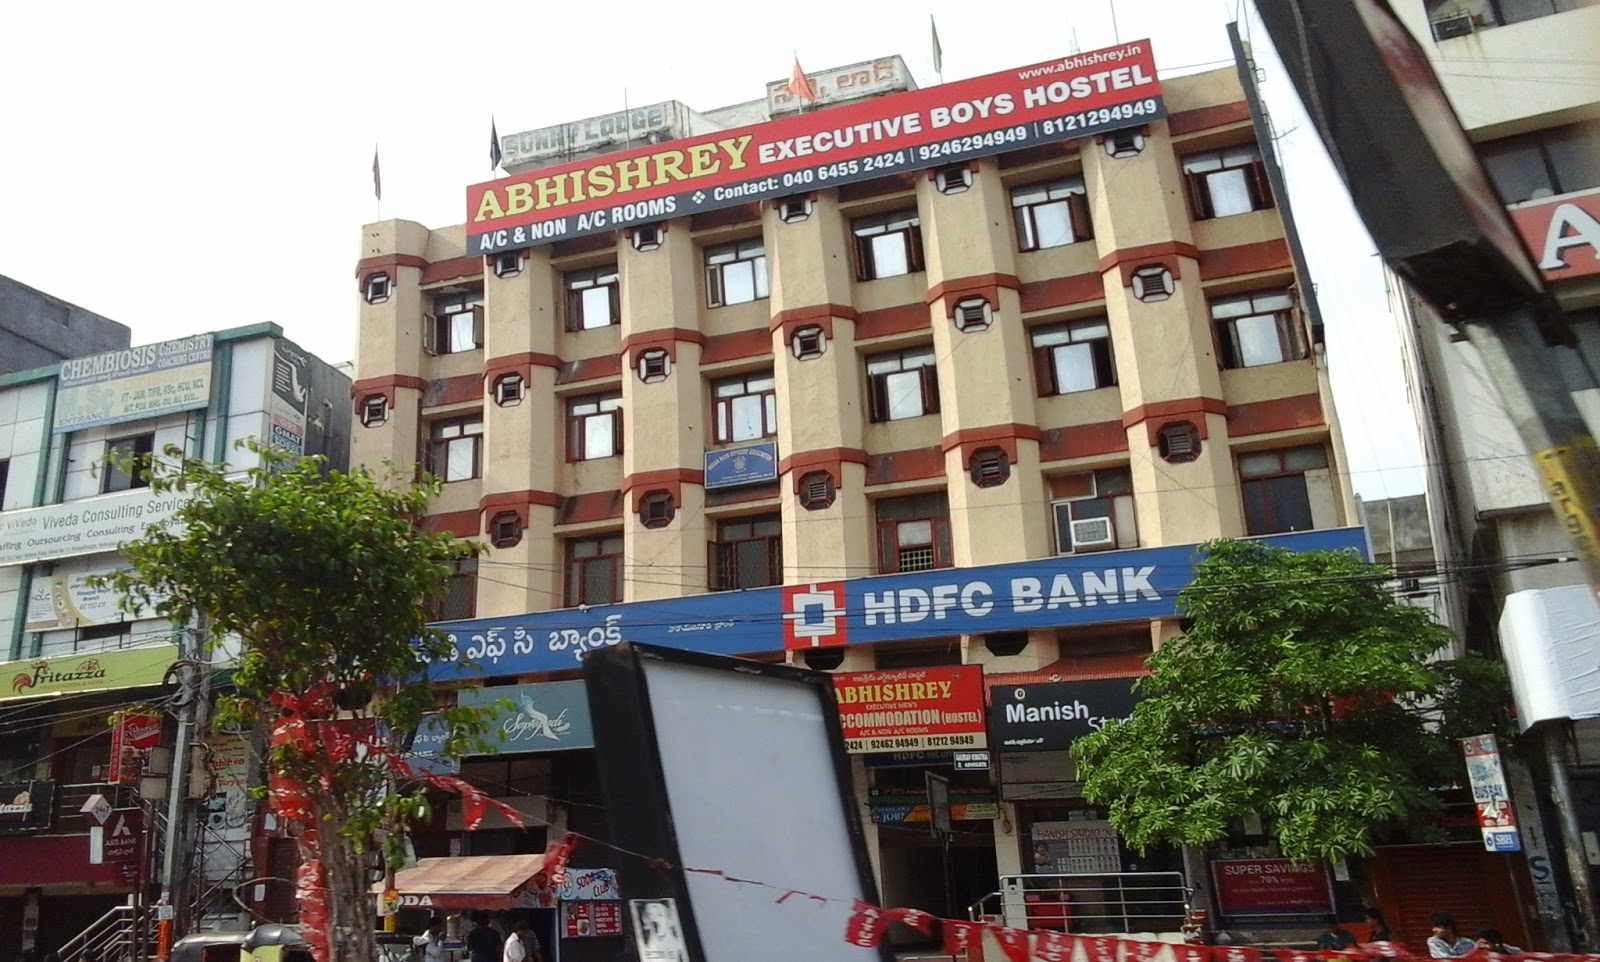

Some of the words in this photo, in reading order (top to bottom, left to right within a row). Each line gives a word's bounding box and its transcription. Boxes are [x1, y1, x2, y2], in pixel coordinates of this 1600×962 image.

[1018, 45, 1141, 80] www.abhishrey.in
[584, 108, 662, 141] LODGE
[473, 134, 753, 223] ABHISHREY
[758, 111, 923, 164] EXECUTIVE
[929, 92, 1016, 129] BOYS
[1023, 64, 1153, 109] HOSTEL
[480, 230, 507, 250] A/C
[513, 226, 526, 243] &
[531, 217, 567, 239] NON
[577, 209, 606, 231] A/C
[611, 196, 677, 224] ROOMS
[713, 177, 779, 201] Contact:
[783, 169, 813, 187] 040
[817, 160, 859, 181] 6455
[863, 151, 905, 172] 2424
[919, 125, 1028, 160] 9246294949
[1043, 99, 1157, 135] 8121294949
[60, 345, 157, 382] CHEMBIOSIS
[159, 334, 212, 356] CHEMISTRY
[275, 426, 301, 444] GMAT
[43, 513, 78, 529] Viveda
[82, 503, 143, 524] Consulting
[146, 497, 196, 514] Service
[27, 532, 81, 547] Outsourcing
[86, 524, 135, 538] Consulting
[864, 581, 994, 626] HDFC
[1011, 564, 1163, 614] BANK
[839, 709, 940, 729] CCOMMODATION
[941, 709, 982, 725] (HOSTEL)
[1006, 700, 1089, 723] Manish
[950, 734, 974, 746] 94949
[1495, 834, 1514, 845] SBH
[1224, 865, 1262, 876] SUPER
